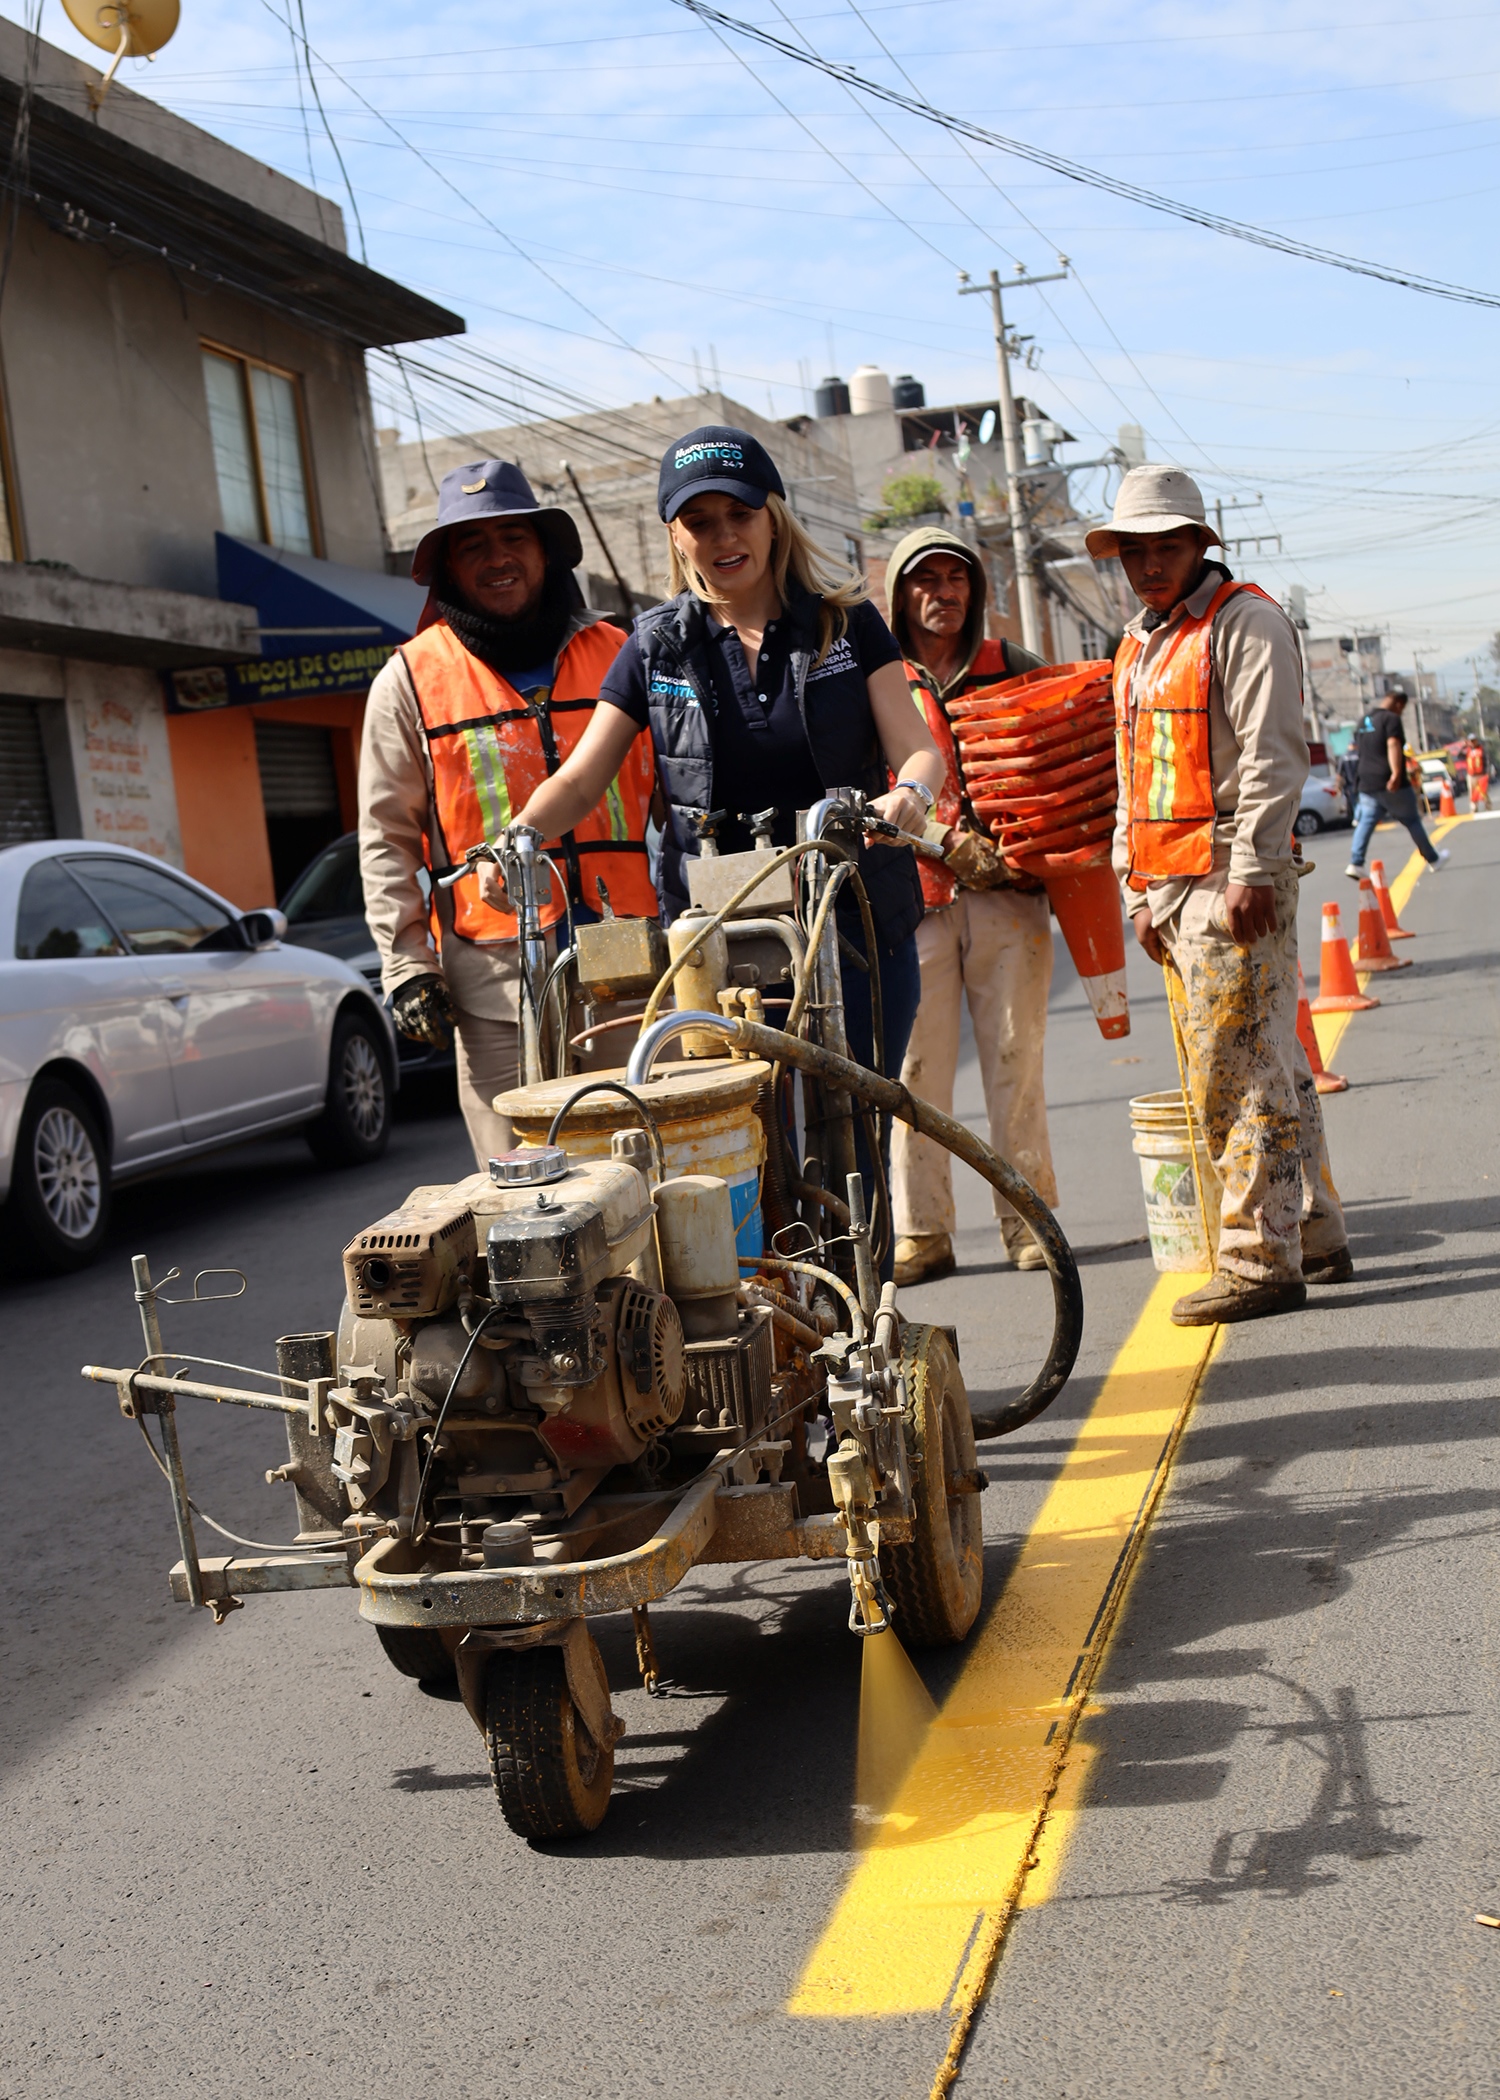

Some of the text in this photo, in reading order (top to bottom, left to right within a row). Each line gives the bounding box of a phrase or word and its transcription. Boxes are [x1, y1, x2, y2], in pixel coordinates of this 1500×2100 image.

[674, 448, 743, 469] CONTIGO
[722, 460, 744, 469] 24/7
[235, 658, 296, 684] TACOS
[300, 655, 325, 675] DE
